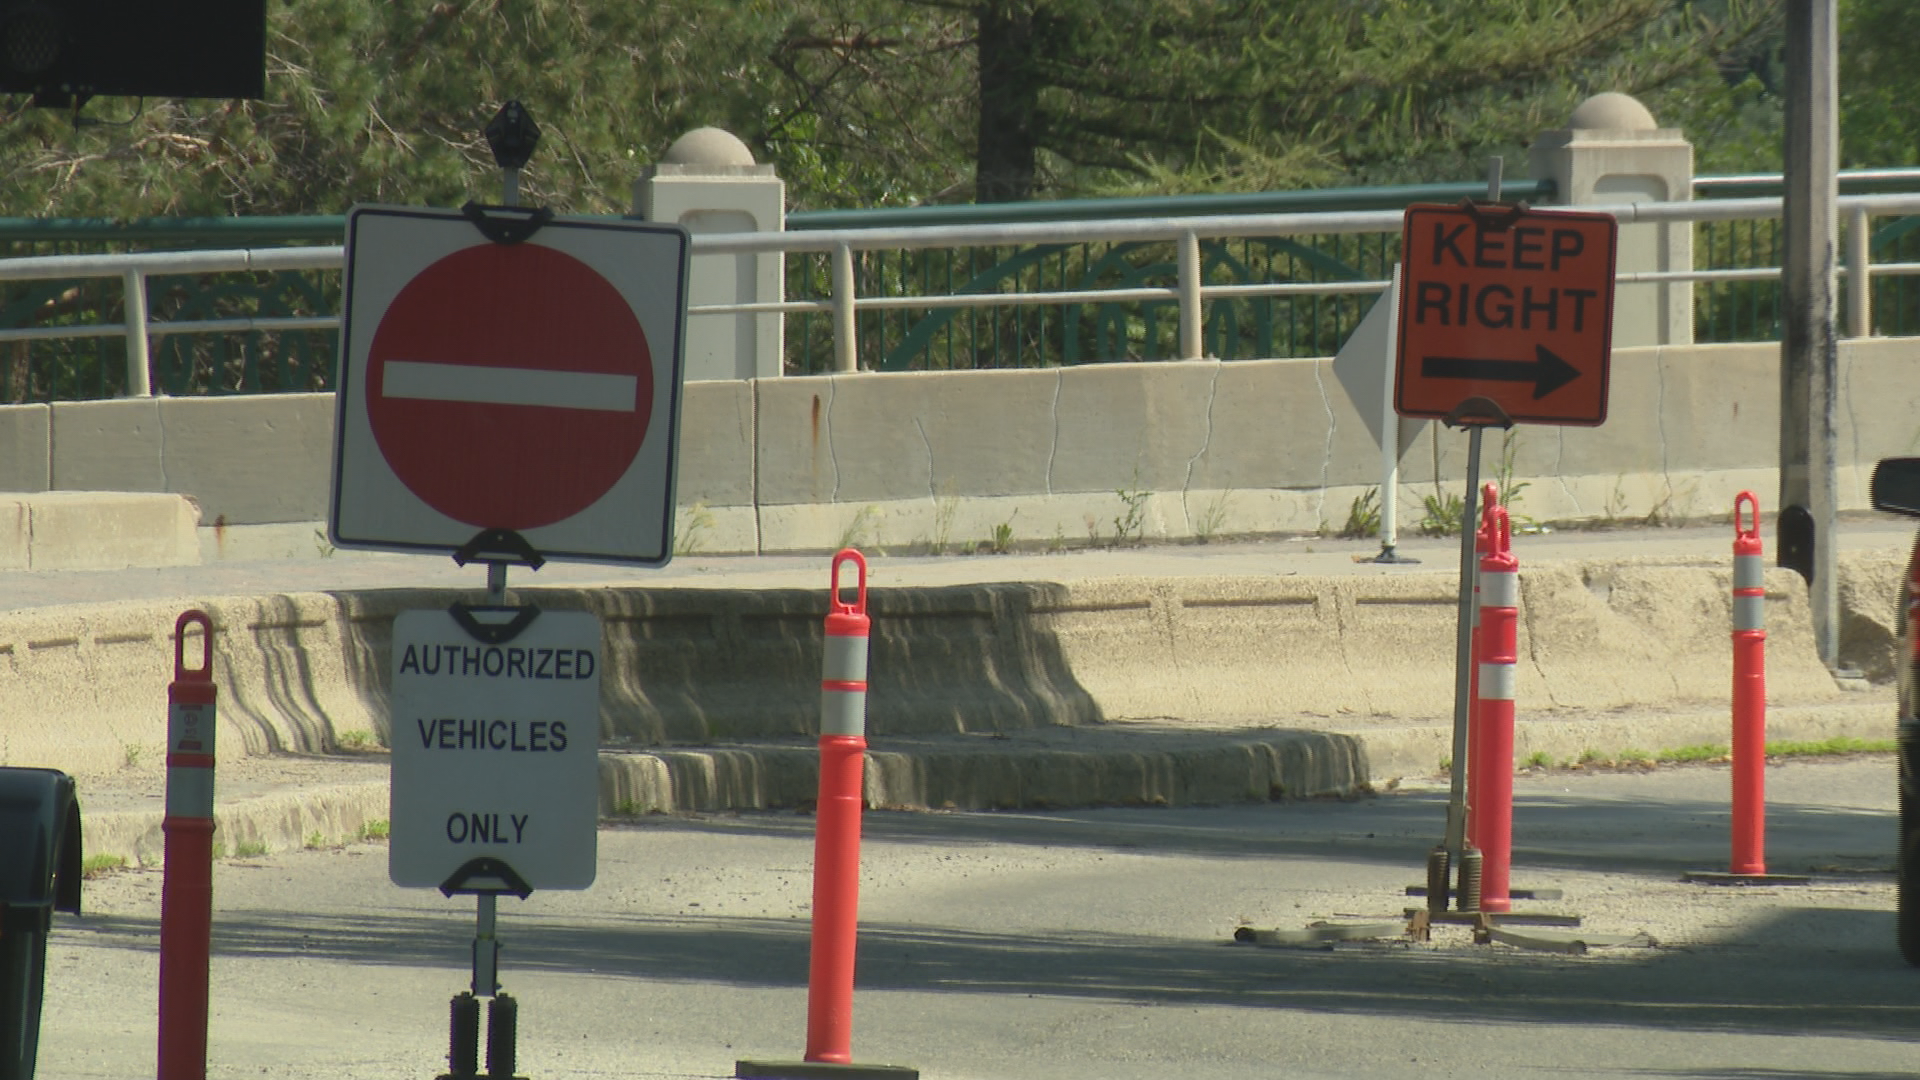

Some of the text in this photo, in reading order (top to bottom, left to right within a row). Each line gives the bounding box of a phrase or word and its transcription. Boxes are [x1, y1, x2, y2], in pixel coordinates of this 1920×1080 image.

[1432, 222, 1585, 271] KEEP
[1416, 282, 1597, 332] RIGHT
[399, 643, 595, 679] AUTHORIZED
[417, 719, 568, 752] VEHICLES
[446, 813, 529, 844] ONLY
